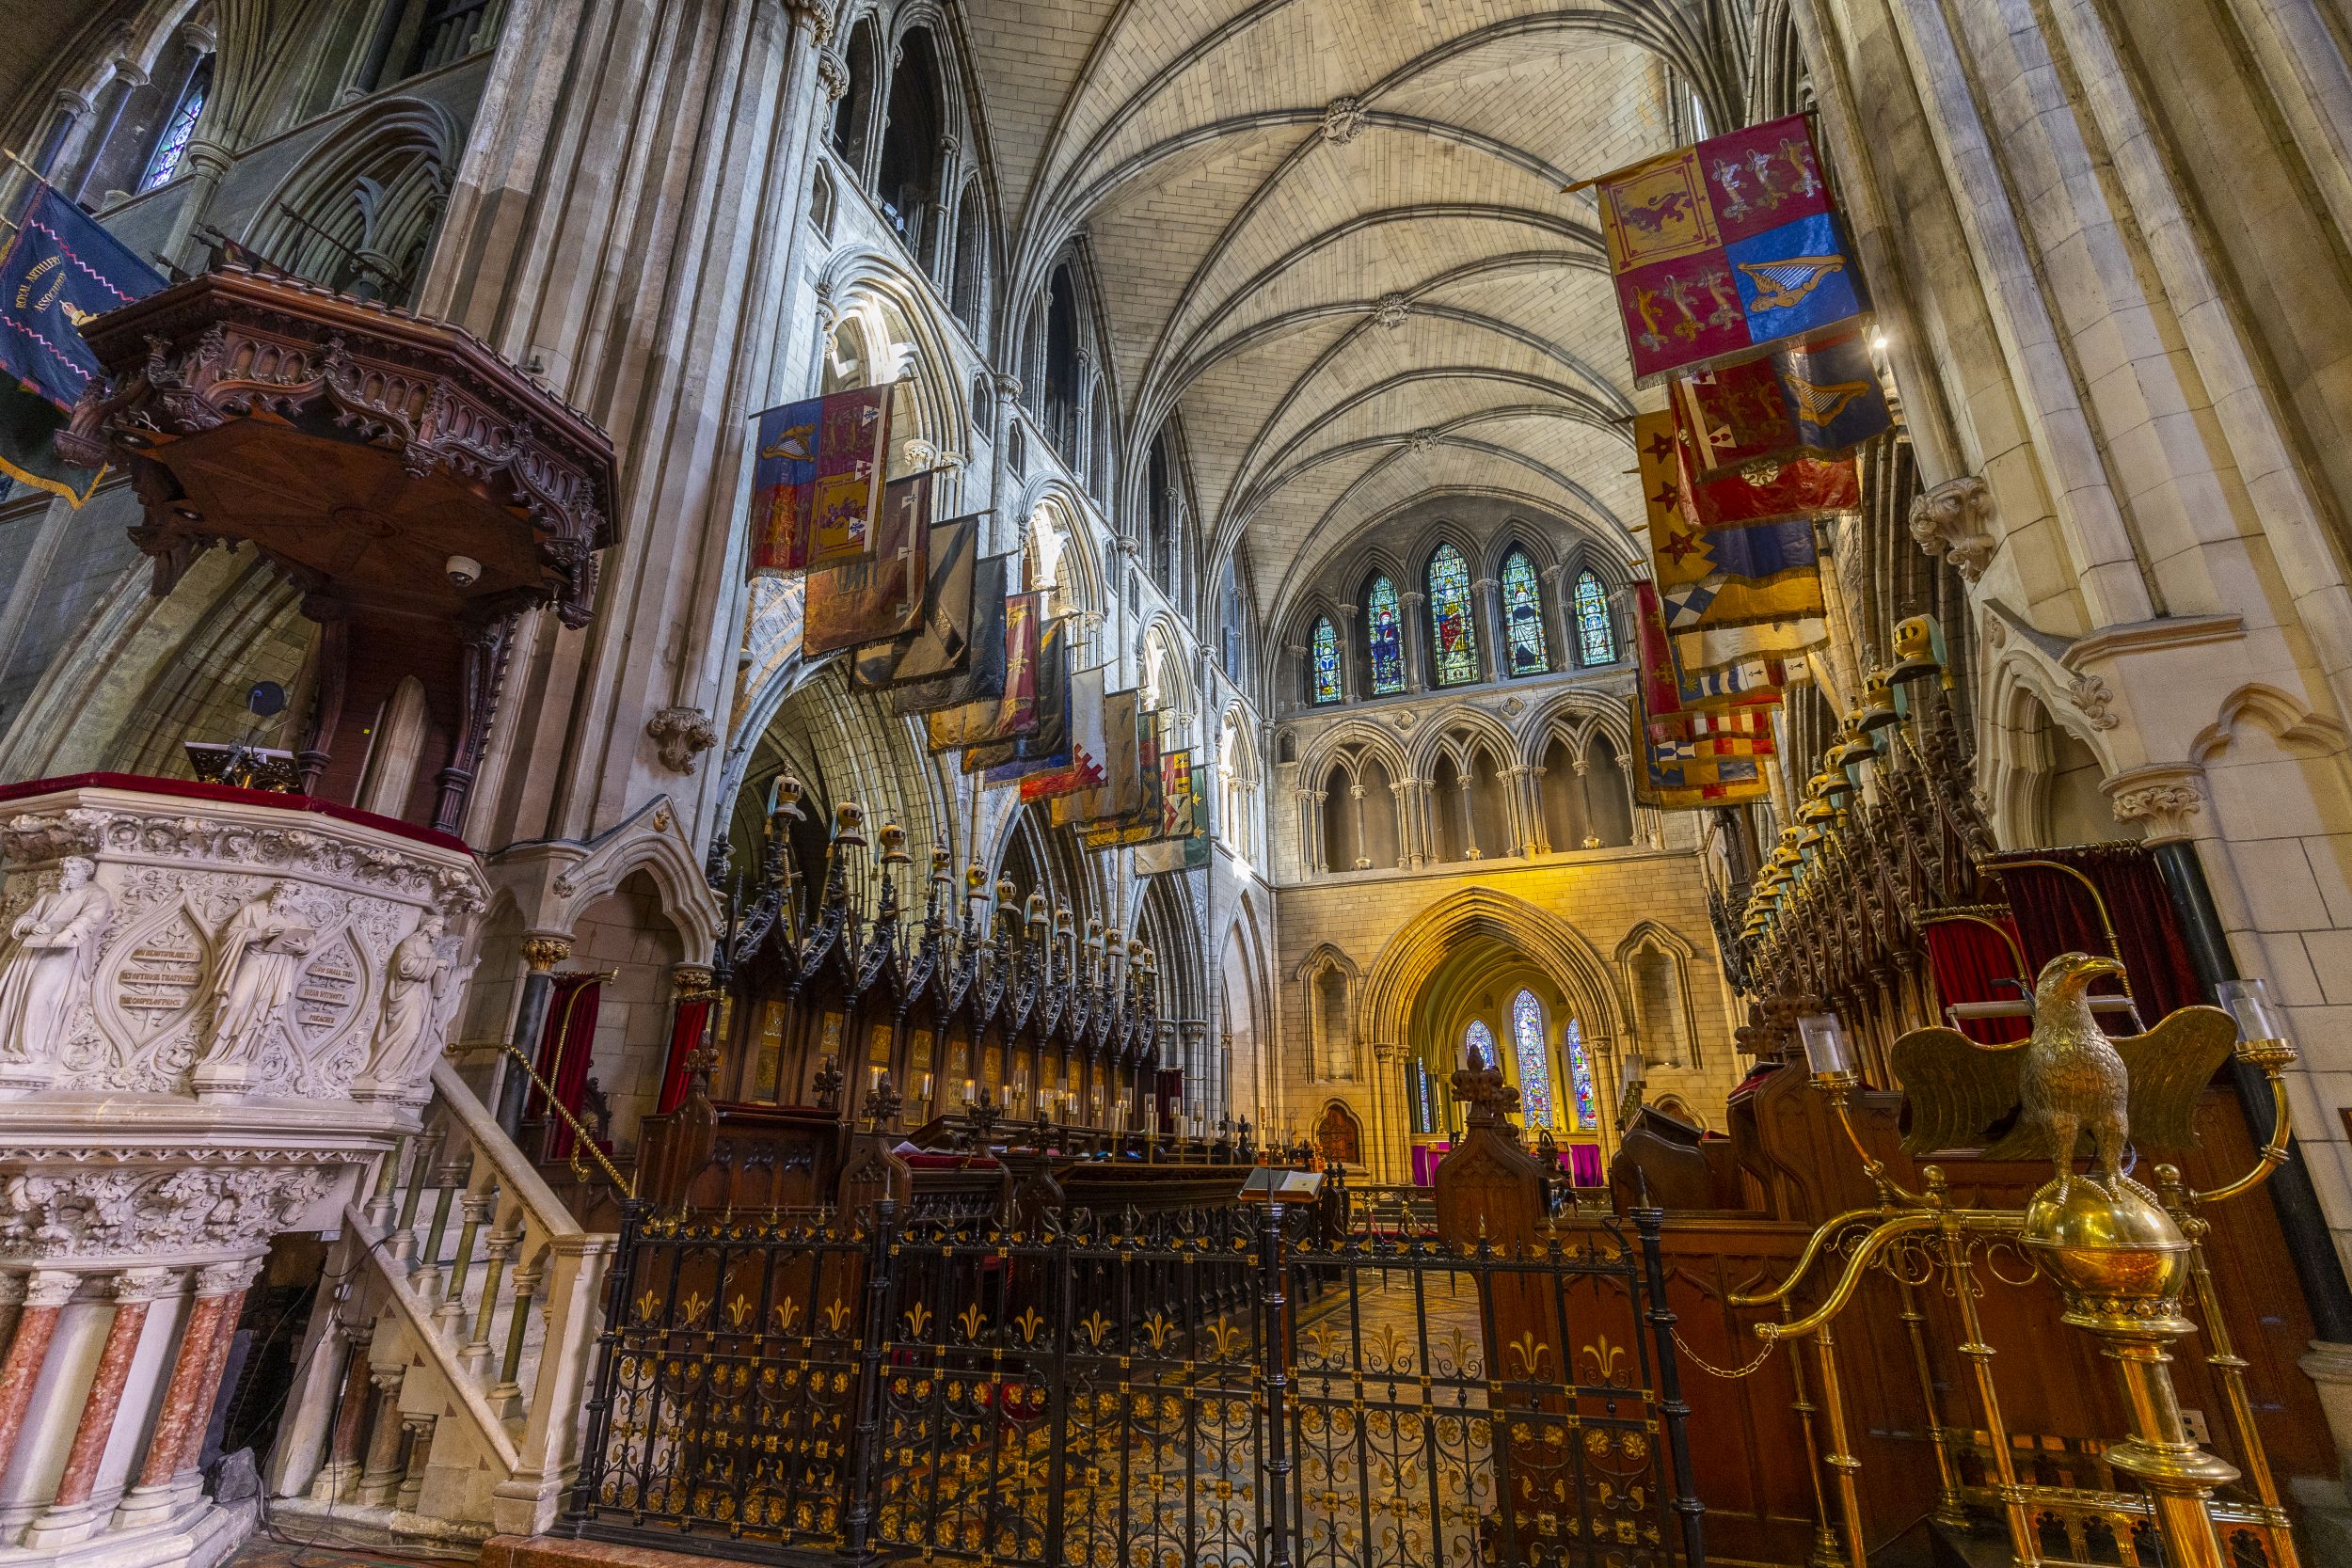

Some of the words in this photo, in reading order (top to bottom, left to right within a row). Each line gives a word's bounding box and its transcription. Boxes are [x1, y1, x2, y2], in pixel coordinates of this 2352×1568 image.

[15, 284, 31, 309] ROYAL
[25, 255, 61, 282] ARTILLERY
[34, 270, 67, 313] ASSOCIATION
[326, 967, 341, 975] SHALL
